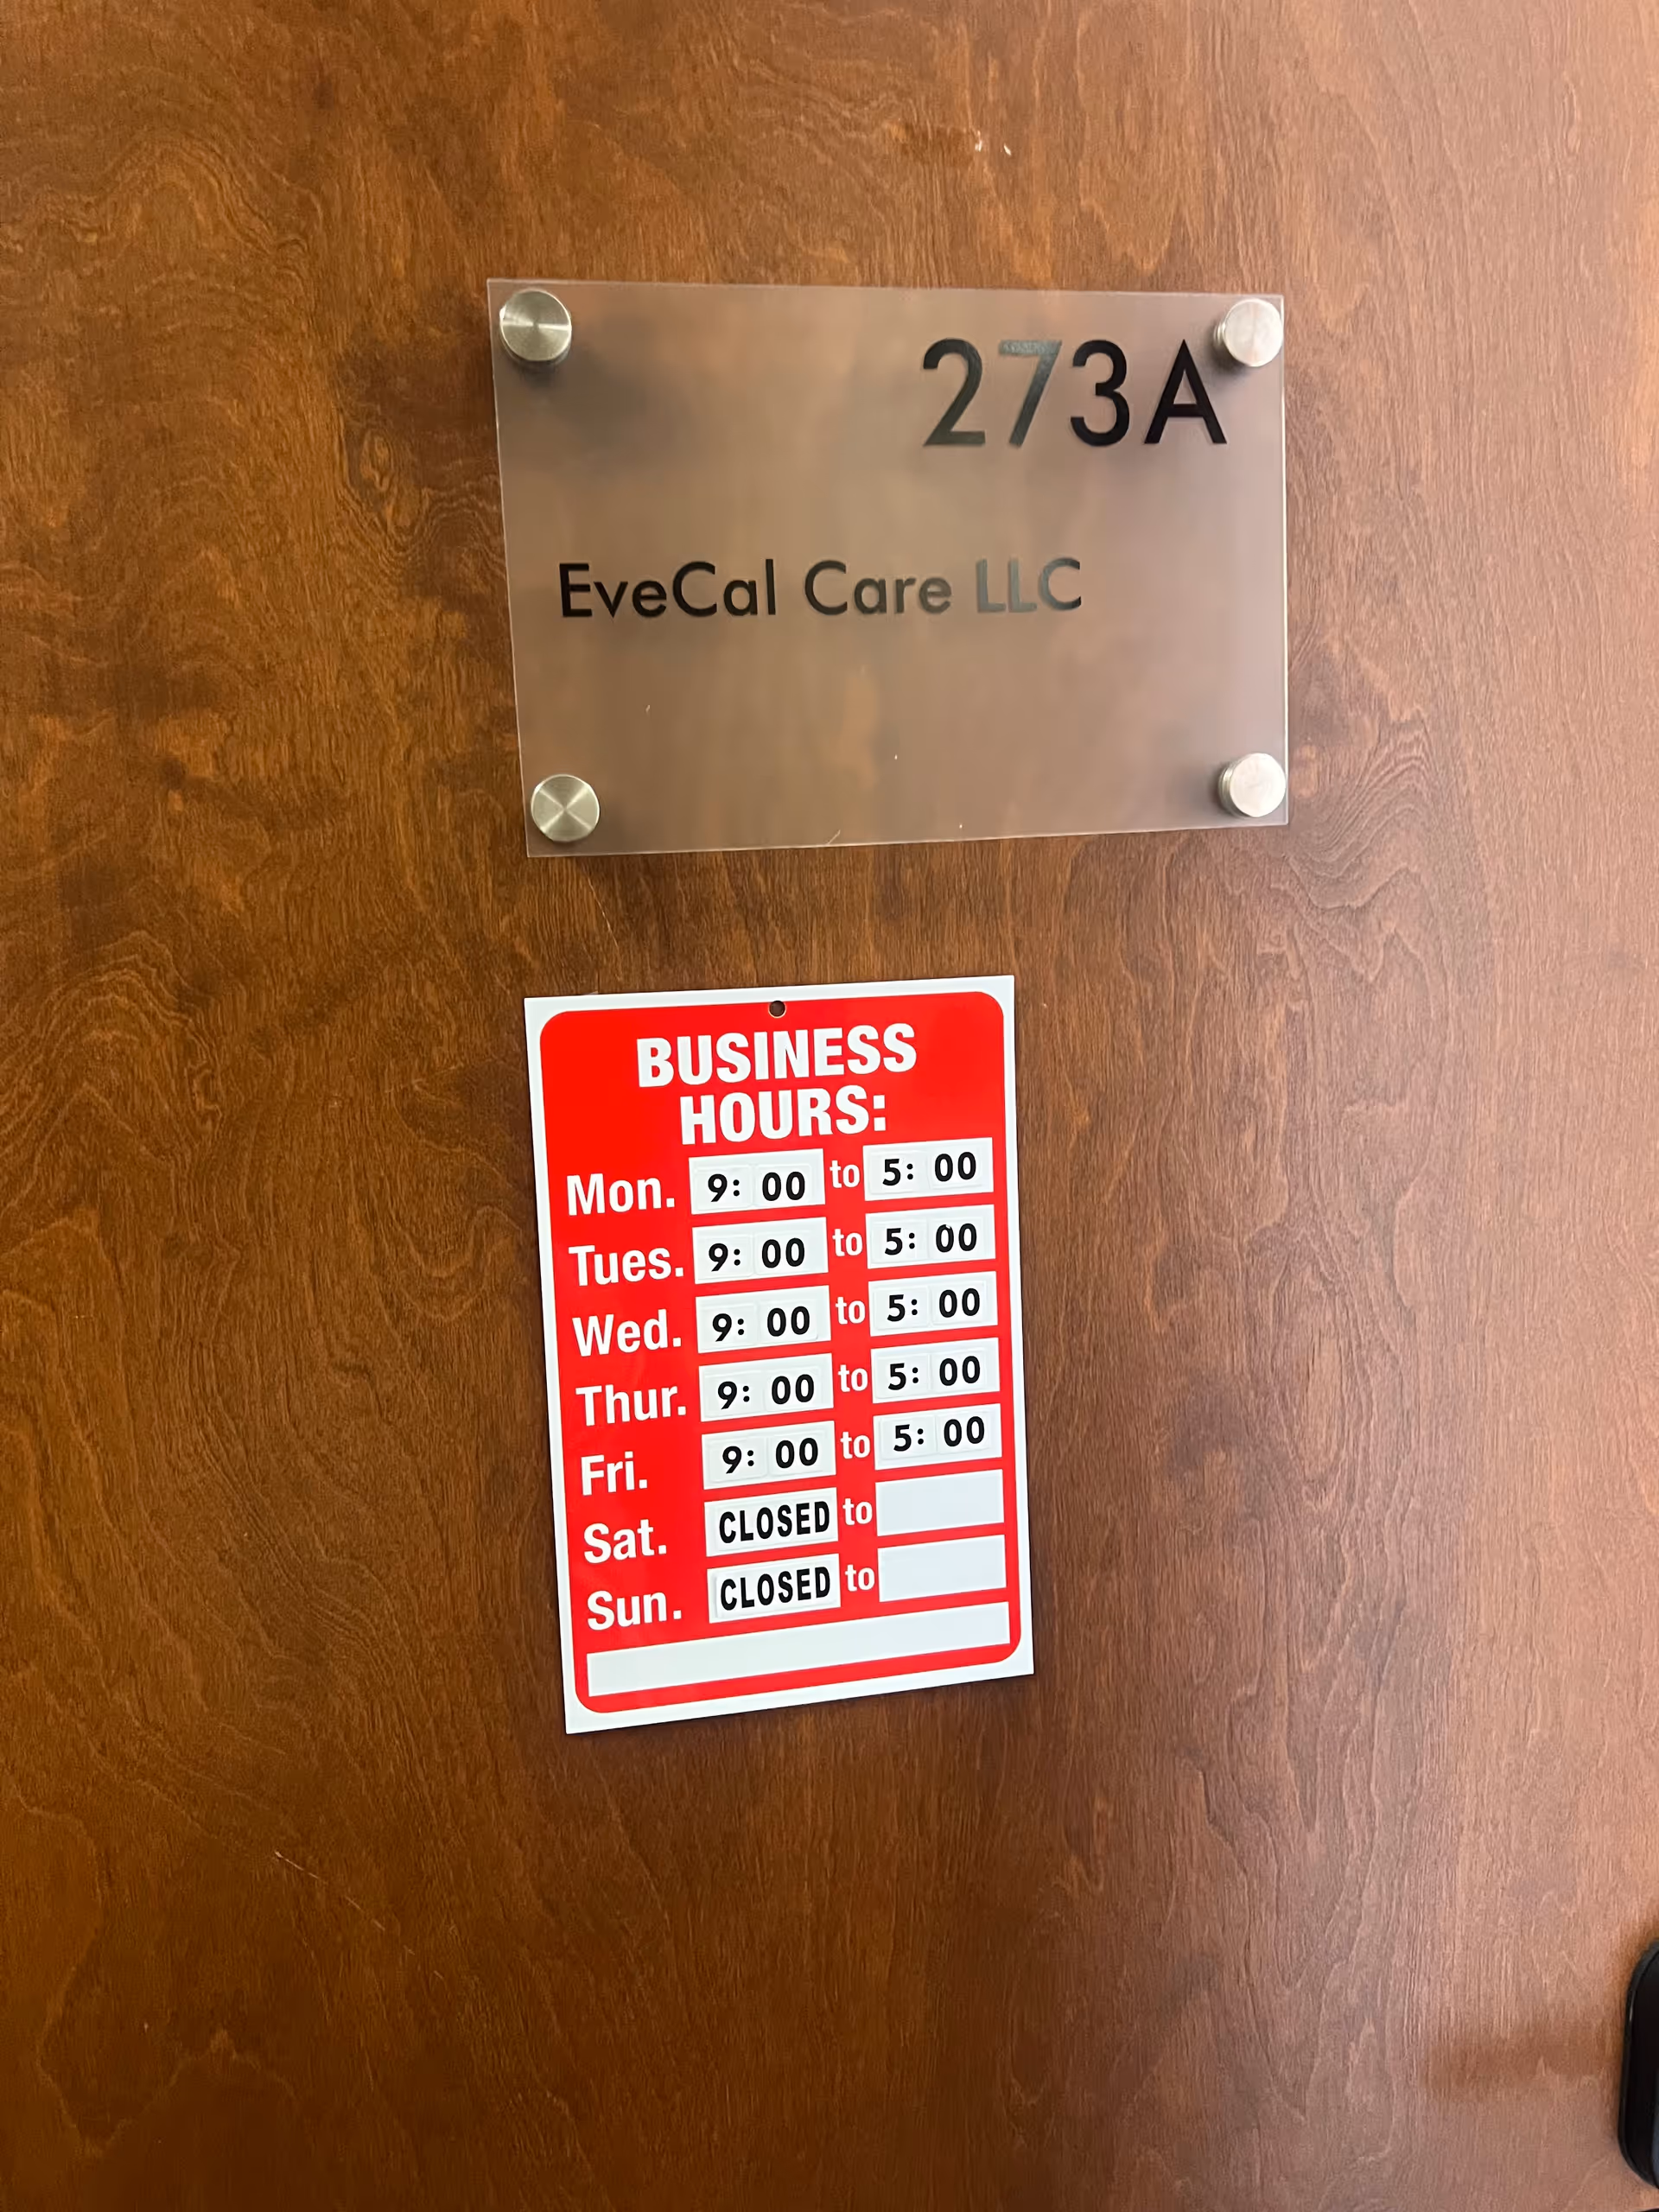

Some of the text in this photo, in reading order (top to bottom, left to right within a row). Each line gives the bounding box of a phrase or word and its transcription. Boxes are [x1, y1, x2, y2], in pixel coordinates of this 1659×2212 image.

[922, 338, 1228, 448] 273A
[558, 557, 1083, 619] EveCal Care LLC
[637, 1022, 917, 1088] BUSINESS
[679, 1085, 887, 1145] HOURS:
[566, 1173, 676, 1216] Mon.
[830, 1160, 861, 1188] to
[569, 1244, 684, 1287] Tues.
[832, 1228, 863, 1256] to
[572, 1309, 682, 1357] Wed.
[836, 1296, 865, 1325] to
[575, 1384, 687, 1427] Thur.
[837, 1363, 868, 1392] to
[580, 1451, 649, 1496] Fri.
[840, 1430, 871, 1459] to
[583, 1496, 873, 1563] Sat. CLOSED to
[586, 1562, 875, 1630] Sun. CLOSED to
